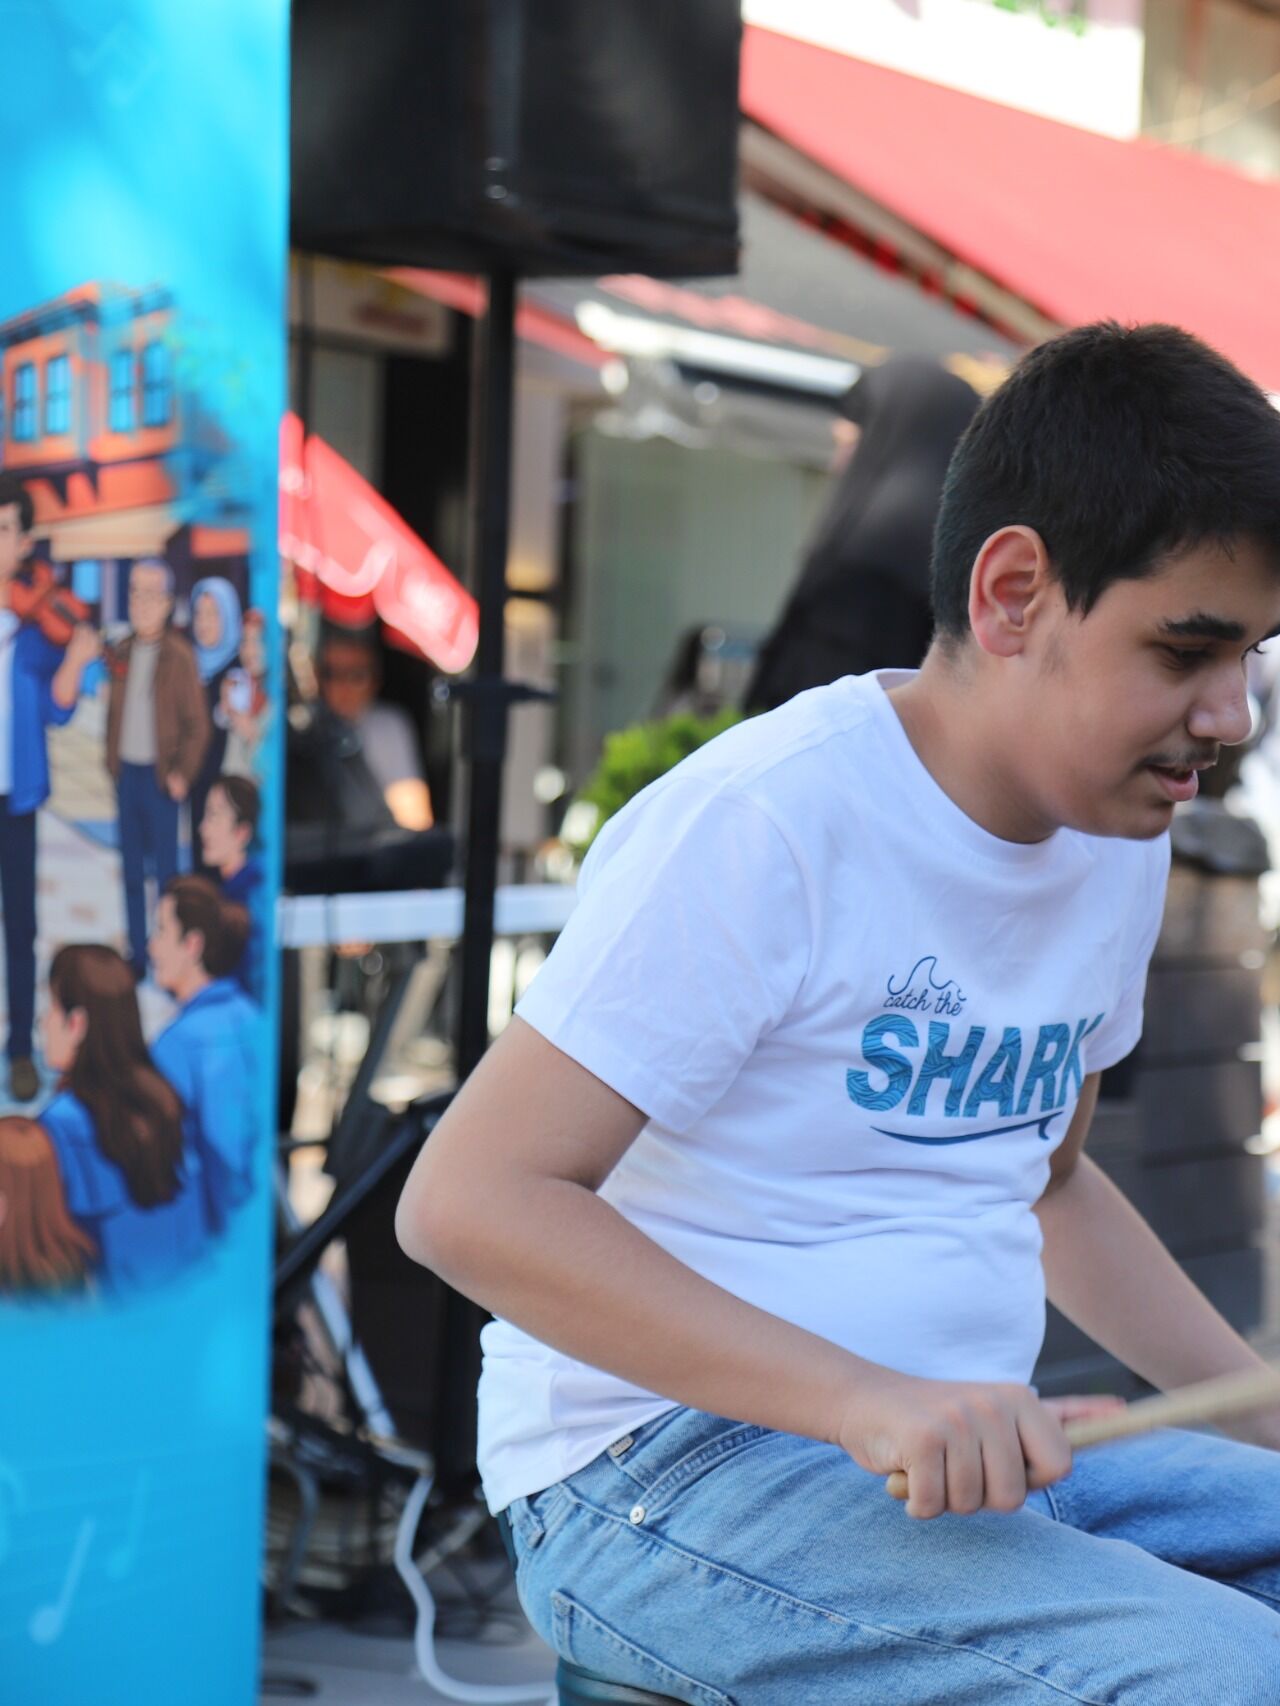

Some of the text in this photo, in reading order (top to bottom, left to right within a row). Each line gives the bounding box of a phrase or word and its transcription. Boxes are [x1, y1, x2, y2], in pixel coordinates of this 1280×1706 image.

[883, 988, 962, 1016] catch the
[846, 1012, 1105, 1118] SHARK
